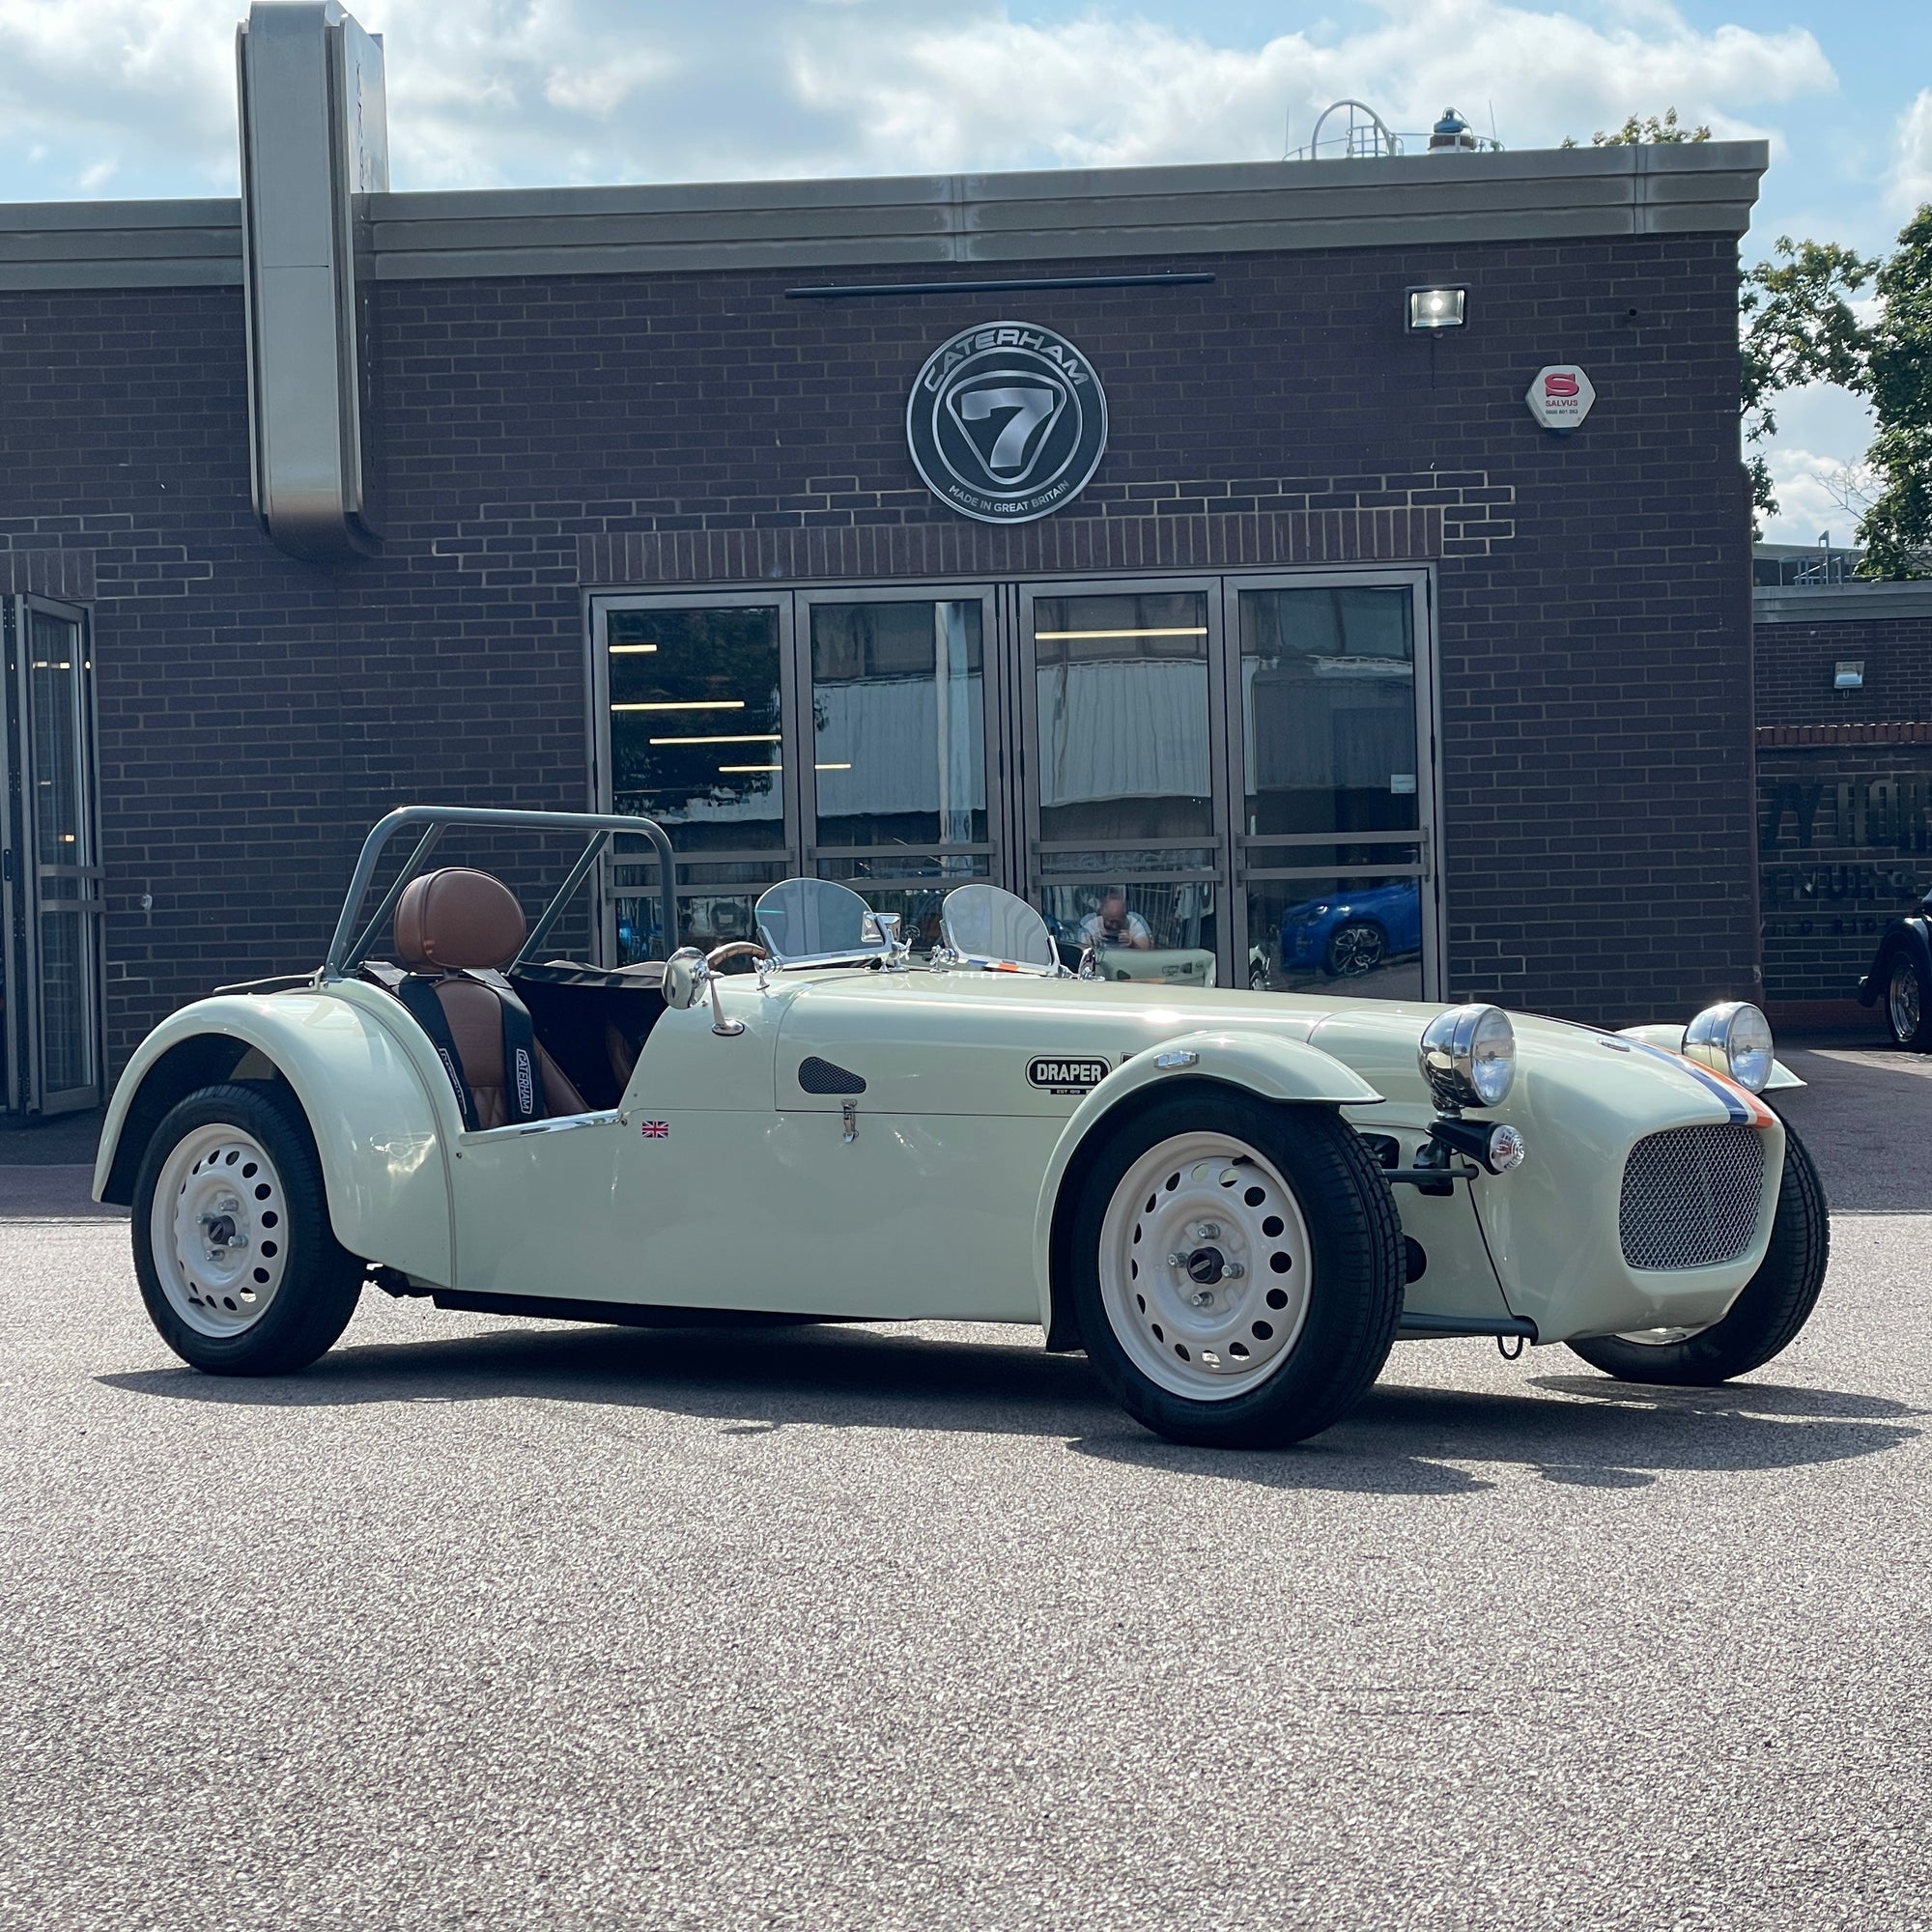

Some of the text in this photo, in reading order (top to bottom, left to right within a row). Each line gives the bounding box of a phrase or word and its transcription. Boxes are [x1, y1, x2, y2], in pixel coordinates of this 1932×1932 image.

[924, 329, 1089, 392] CATERHAM
[961, 387, 1053, 468] 7
[949, 480, 1069, 512] MADE IN GREAT BRITAIN
[519, 1052, 529, 1110] CATERHAM
[1037, 1064, 1101, 1081] DRAPER
